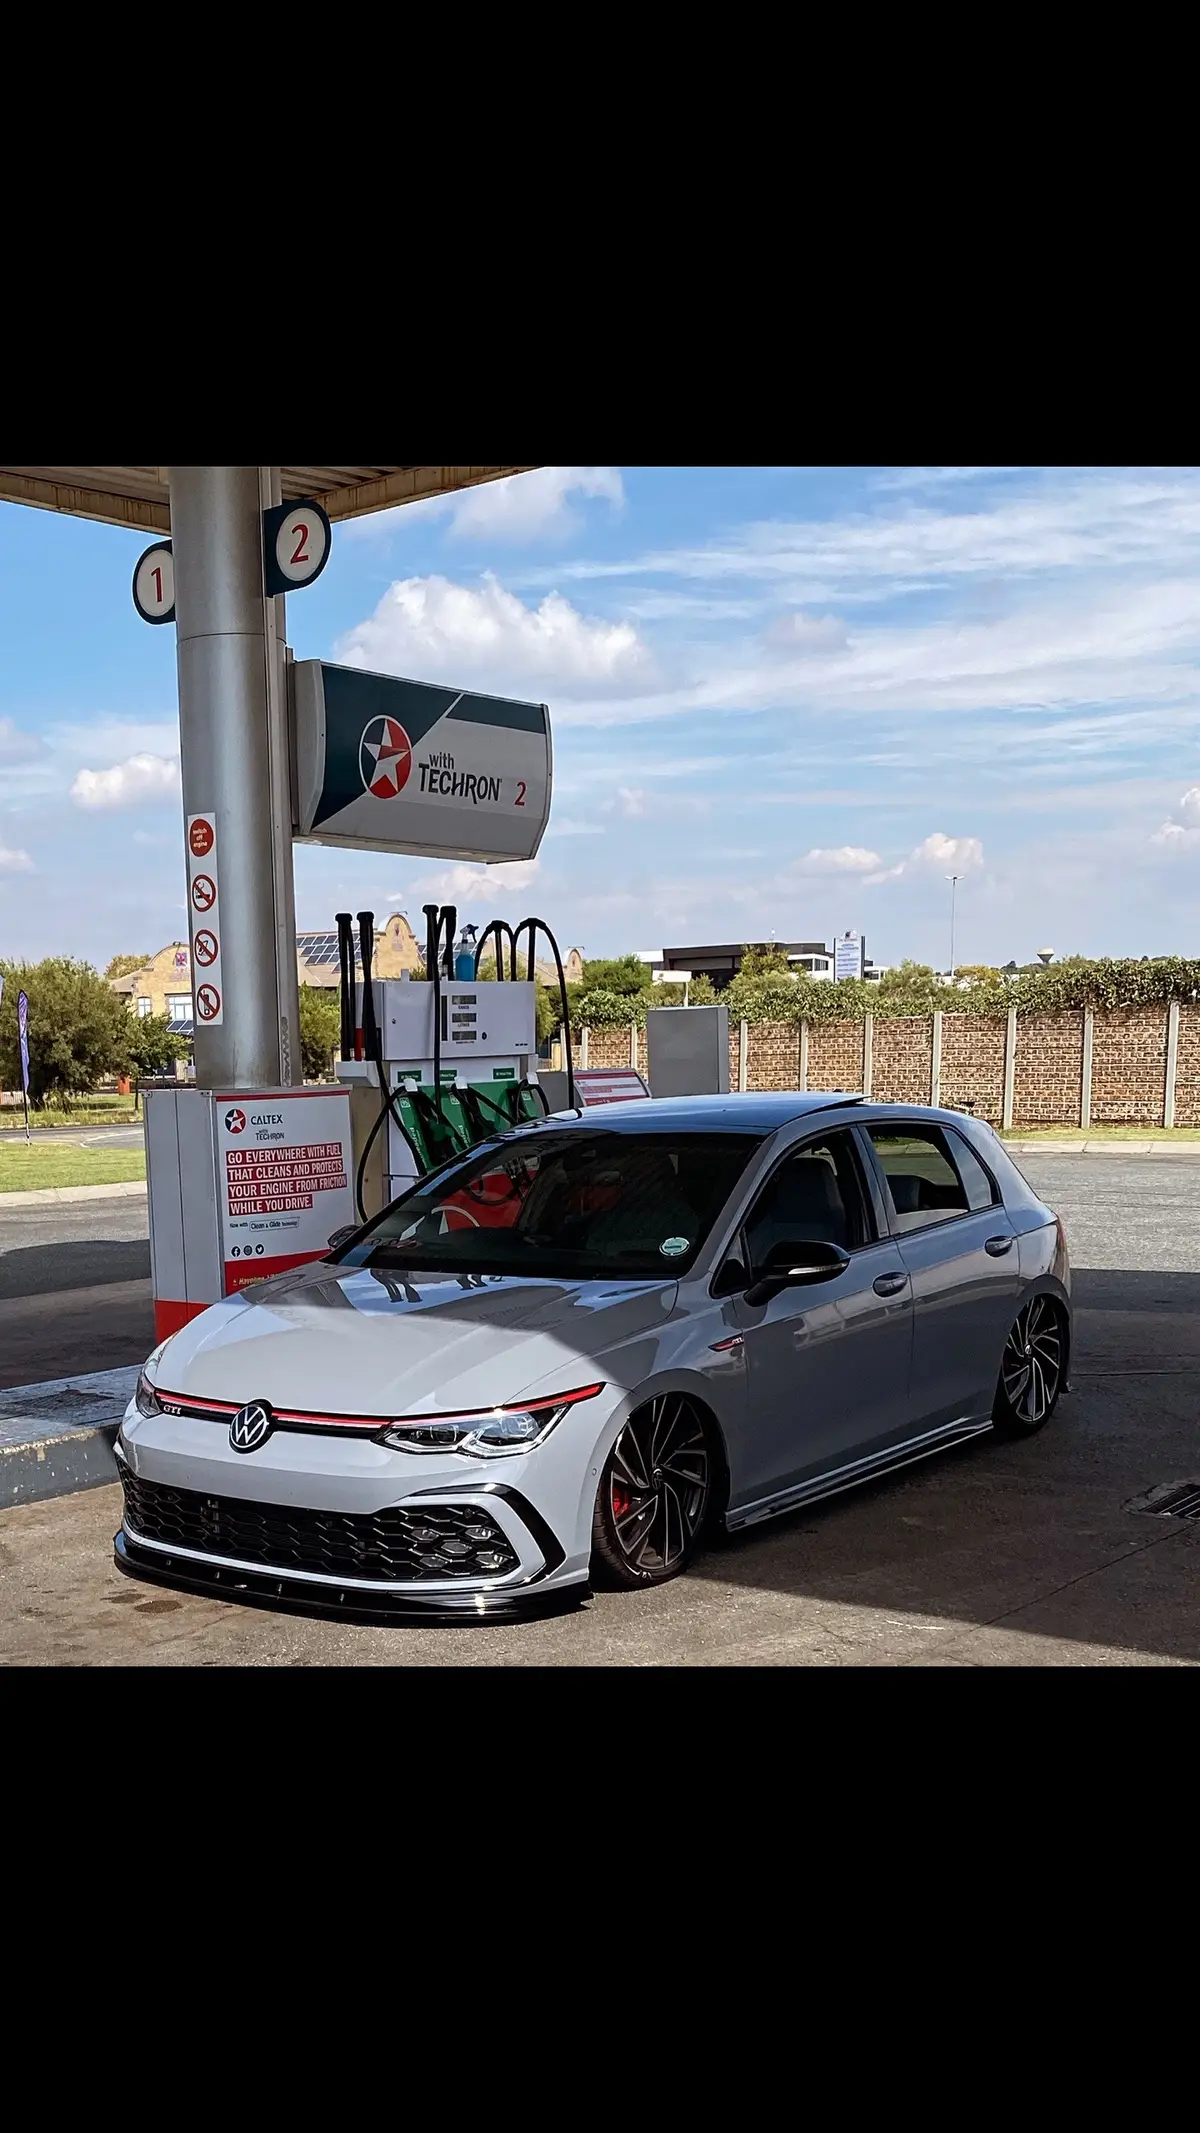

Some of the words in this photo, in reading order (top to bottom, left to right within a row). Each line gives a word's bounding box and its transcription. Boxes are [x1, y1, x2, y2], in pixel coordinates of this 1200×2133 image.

[290, 524, 309, 565] 2
[151, 567, 163, 602] 1
[429, 752, 454, 769] with
[418, 762, 501, 804] TECHRON
[514, 781, 527, 806] 2
[250, 1114, 283, 1125] CALTEX
[255, 1132, 284, 1141] TECHRON
[227, 1152, 243, 1164] GO
[245, 1147, 306, 1163] EVERYWHERE
[307, 1145, 325, 1158] WITH
[326, 1143, 341, 1156] FUEL
[228, 1168, 254, 1181] THAT
[256, 1165, 291, 1179] CLEANS
[293, 1164, 310, 1176] AND
[311, 1160, 343, 1174] PROTECTS
[229, 1185, 257, 1198] YOUR
[260, 1181, 294, 1195] ENGINE
[296, 1179, 318, 1192] FROM
[320, 1176, 346, 1190] FRICTION
[230, 1200, 263, 1215] WHILE
[265, 1198, 284, 1211] YOU
[285, 1196, 312, 1209] DRIVE.
[163, 1404, 181, 1414] GTI
